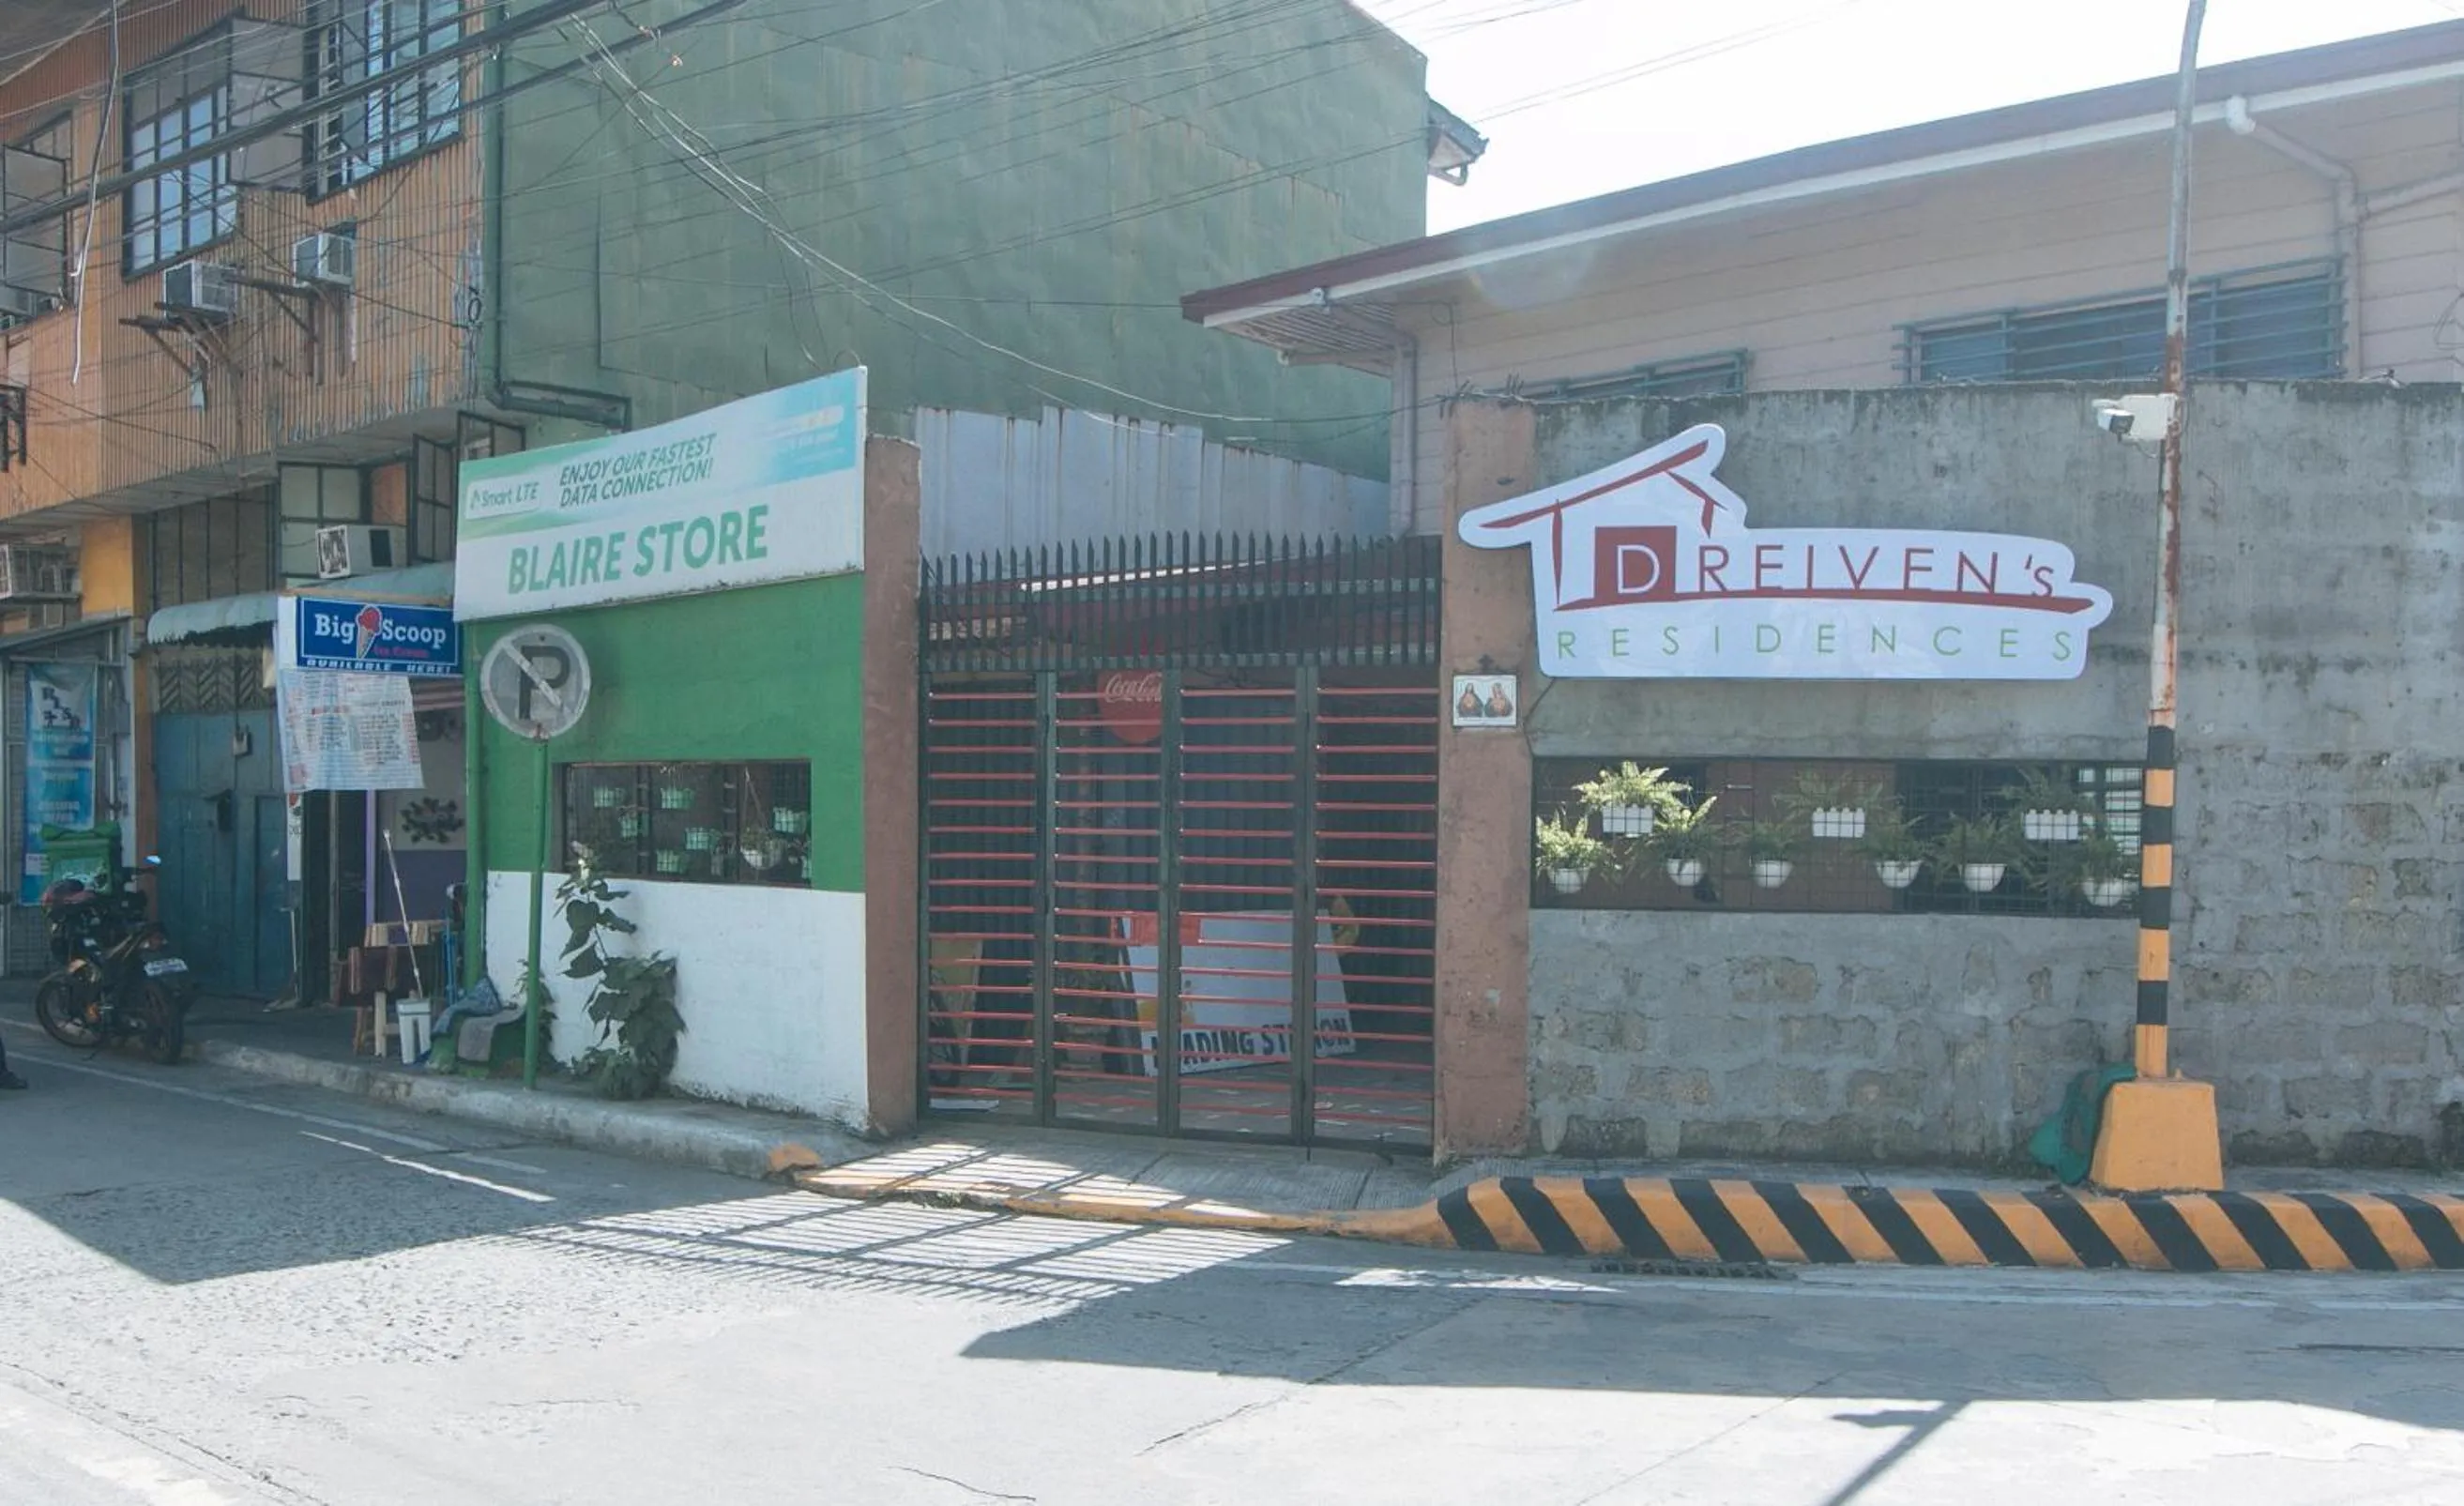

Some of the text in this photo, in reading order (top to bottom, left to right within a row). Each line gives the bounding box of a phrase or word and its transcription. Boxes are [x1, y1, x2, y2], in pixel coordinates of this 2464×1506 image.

[559, 433, 717, 488] ENJOY OUR FASTEST
[559, 457, 714, 509] DATA CONNECTION!
[480, 481, 540, 507] Smart LTE
[508, 504, 768, 595] BLAIRE STORE
[314, 613, 447, 649] Big Scoop
[1557, 623, 2072, 662] RESIDENCES
[518, 645, 570, 721] P
